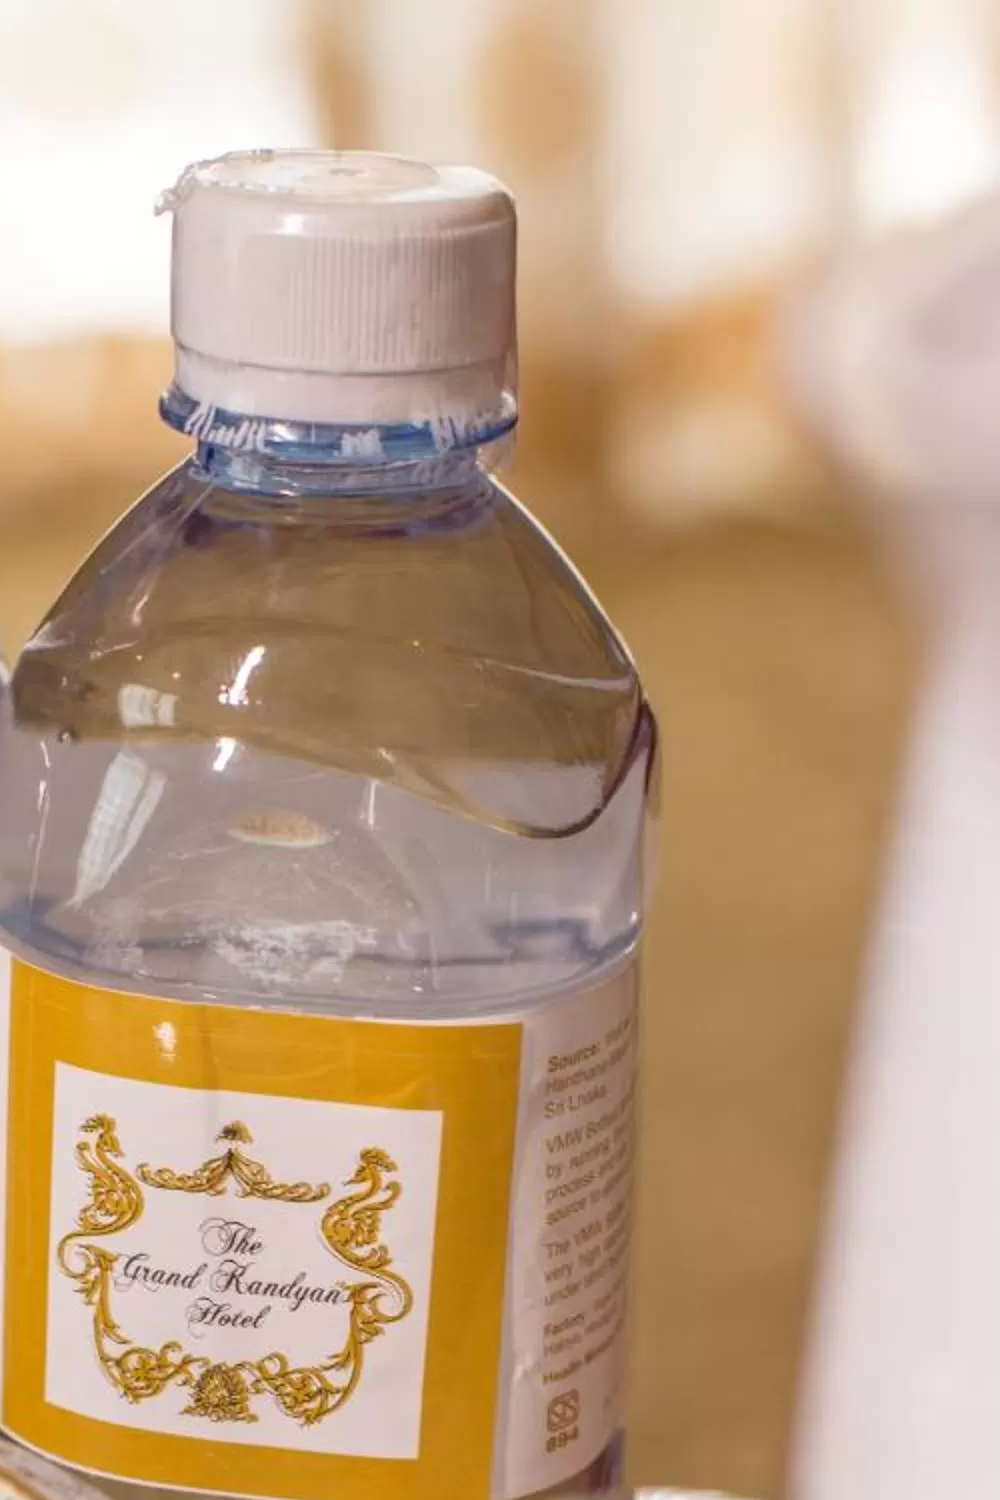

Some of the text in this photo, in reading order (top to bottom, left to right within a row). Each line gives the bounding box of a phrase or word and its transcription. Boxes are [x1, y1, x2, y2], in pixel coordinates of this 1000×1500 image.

[199, 1216, 266, 1256] The
[115, 1251, 209, 1292] Grand
[184, 1296, 272, 1339] Hotel
